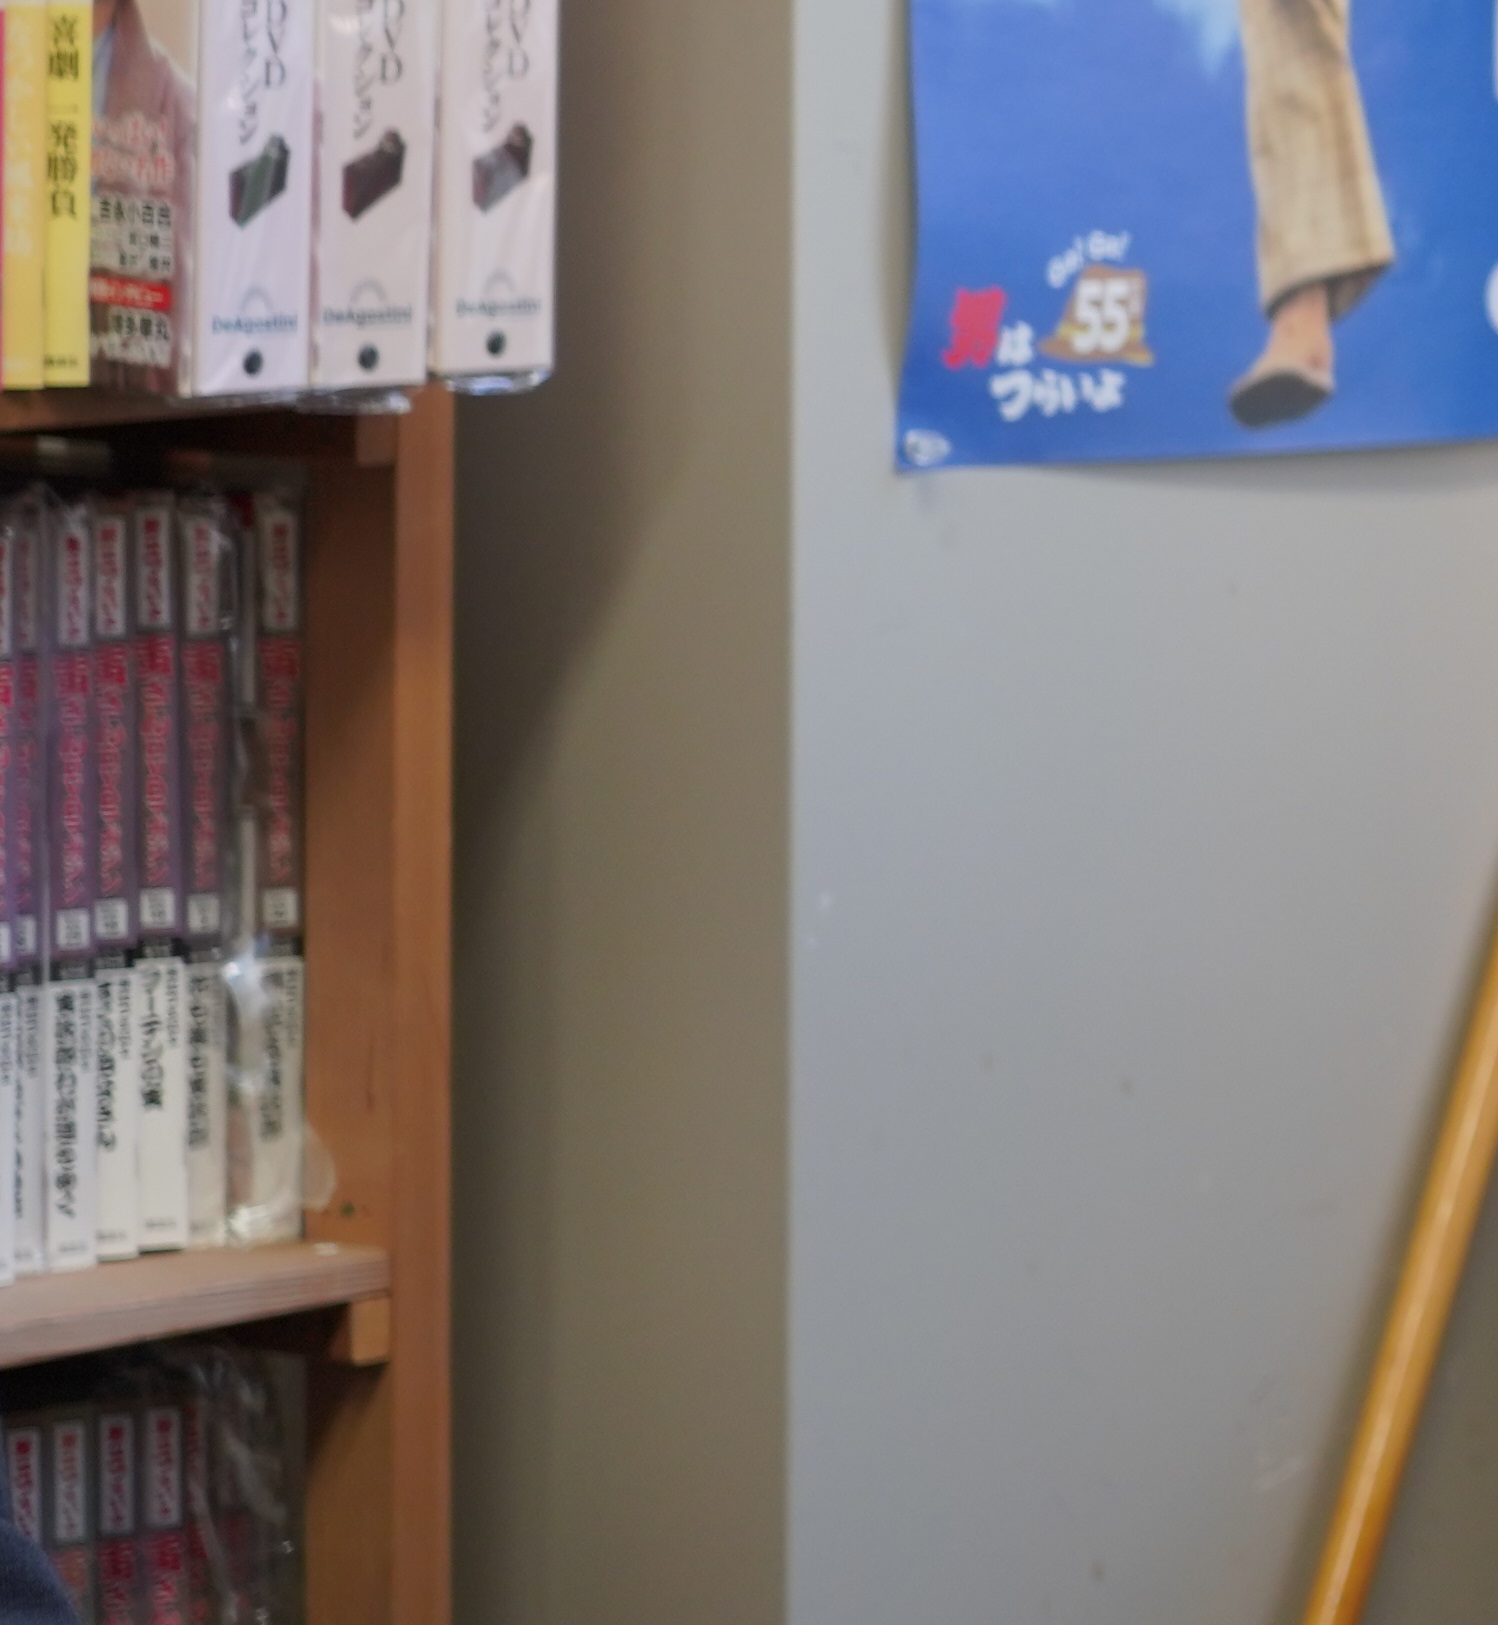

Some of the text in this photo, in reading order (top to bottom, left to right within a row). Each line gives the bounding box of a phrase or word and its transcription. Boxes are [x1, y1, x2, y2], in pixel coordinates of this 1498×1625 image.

[942, 284, 1035, 372] 男は
[1073, 278, 1130, 355] 55
[988, 368, 1127, 423] つらいよ
